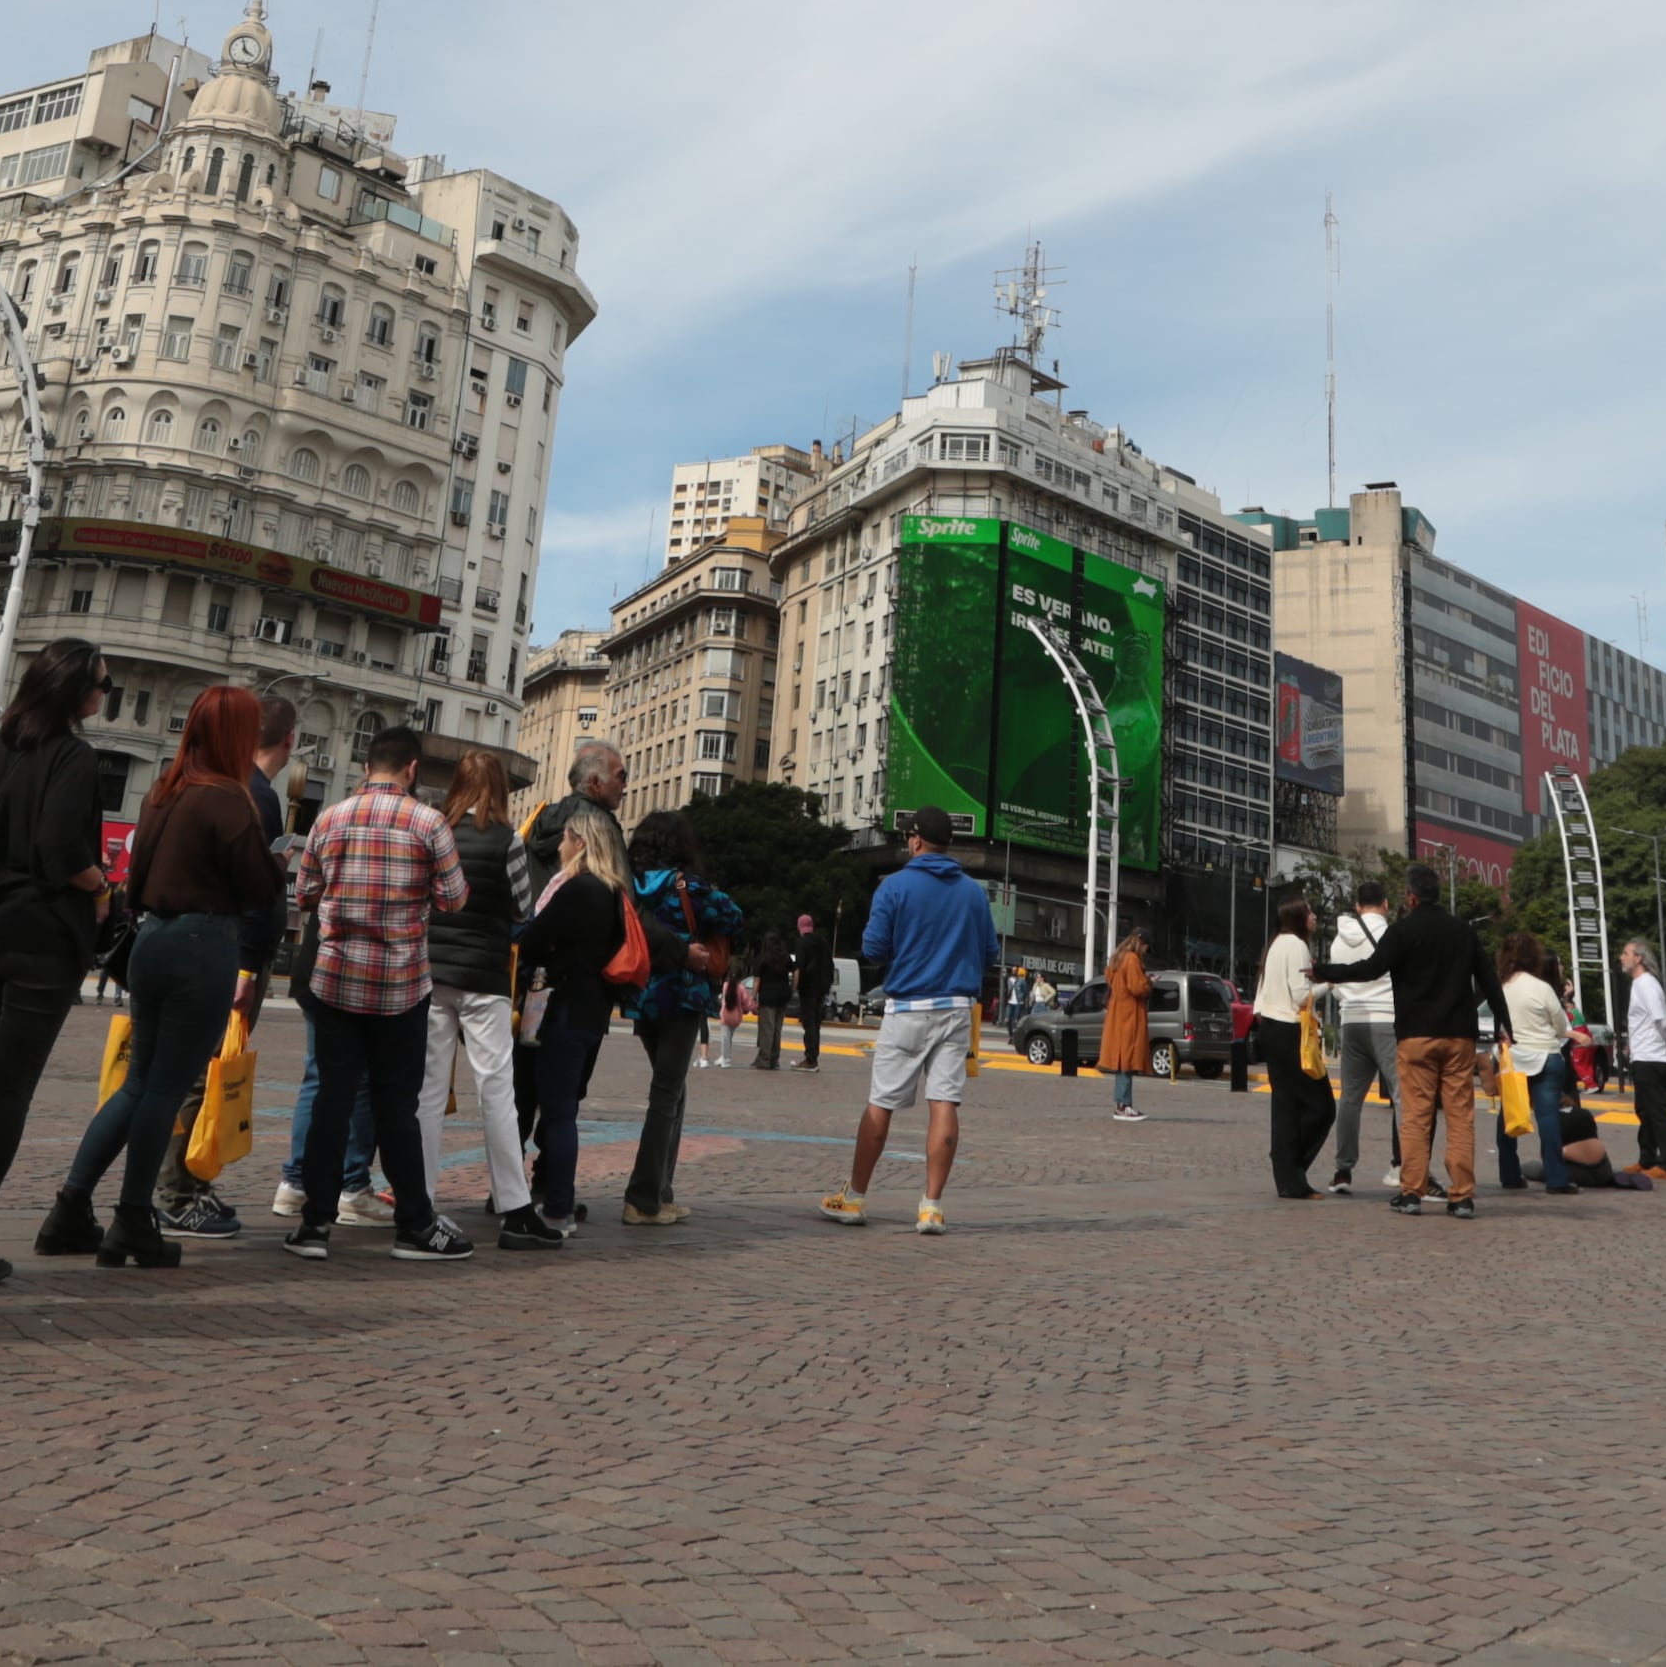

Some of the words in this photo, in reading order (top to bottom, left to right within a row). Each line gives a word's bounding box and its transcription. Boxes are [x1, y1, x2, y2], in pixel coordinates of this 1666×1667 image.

[917, 519, 977, 538] Sprite
[1011, 527, 1041, 551] Sprite
[317, 572, 353, 595] Nuevas
[354, 583, 404, 609] McOfertas
[1013, 584, 1035, 606] ES
[1528, 624, 1549, 660] EDI
[1539, 660, 1574, 699] FICIO
[1530, 686, 1555, 722] DEL
[1541, 721, 1580, 762] PLATA
[1022, 955, 1046, 971] TIENDA
[1047, 959, 1057, 973] DE
